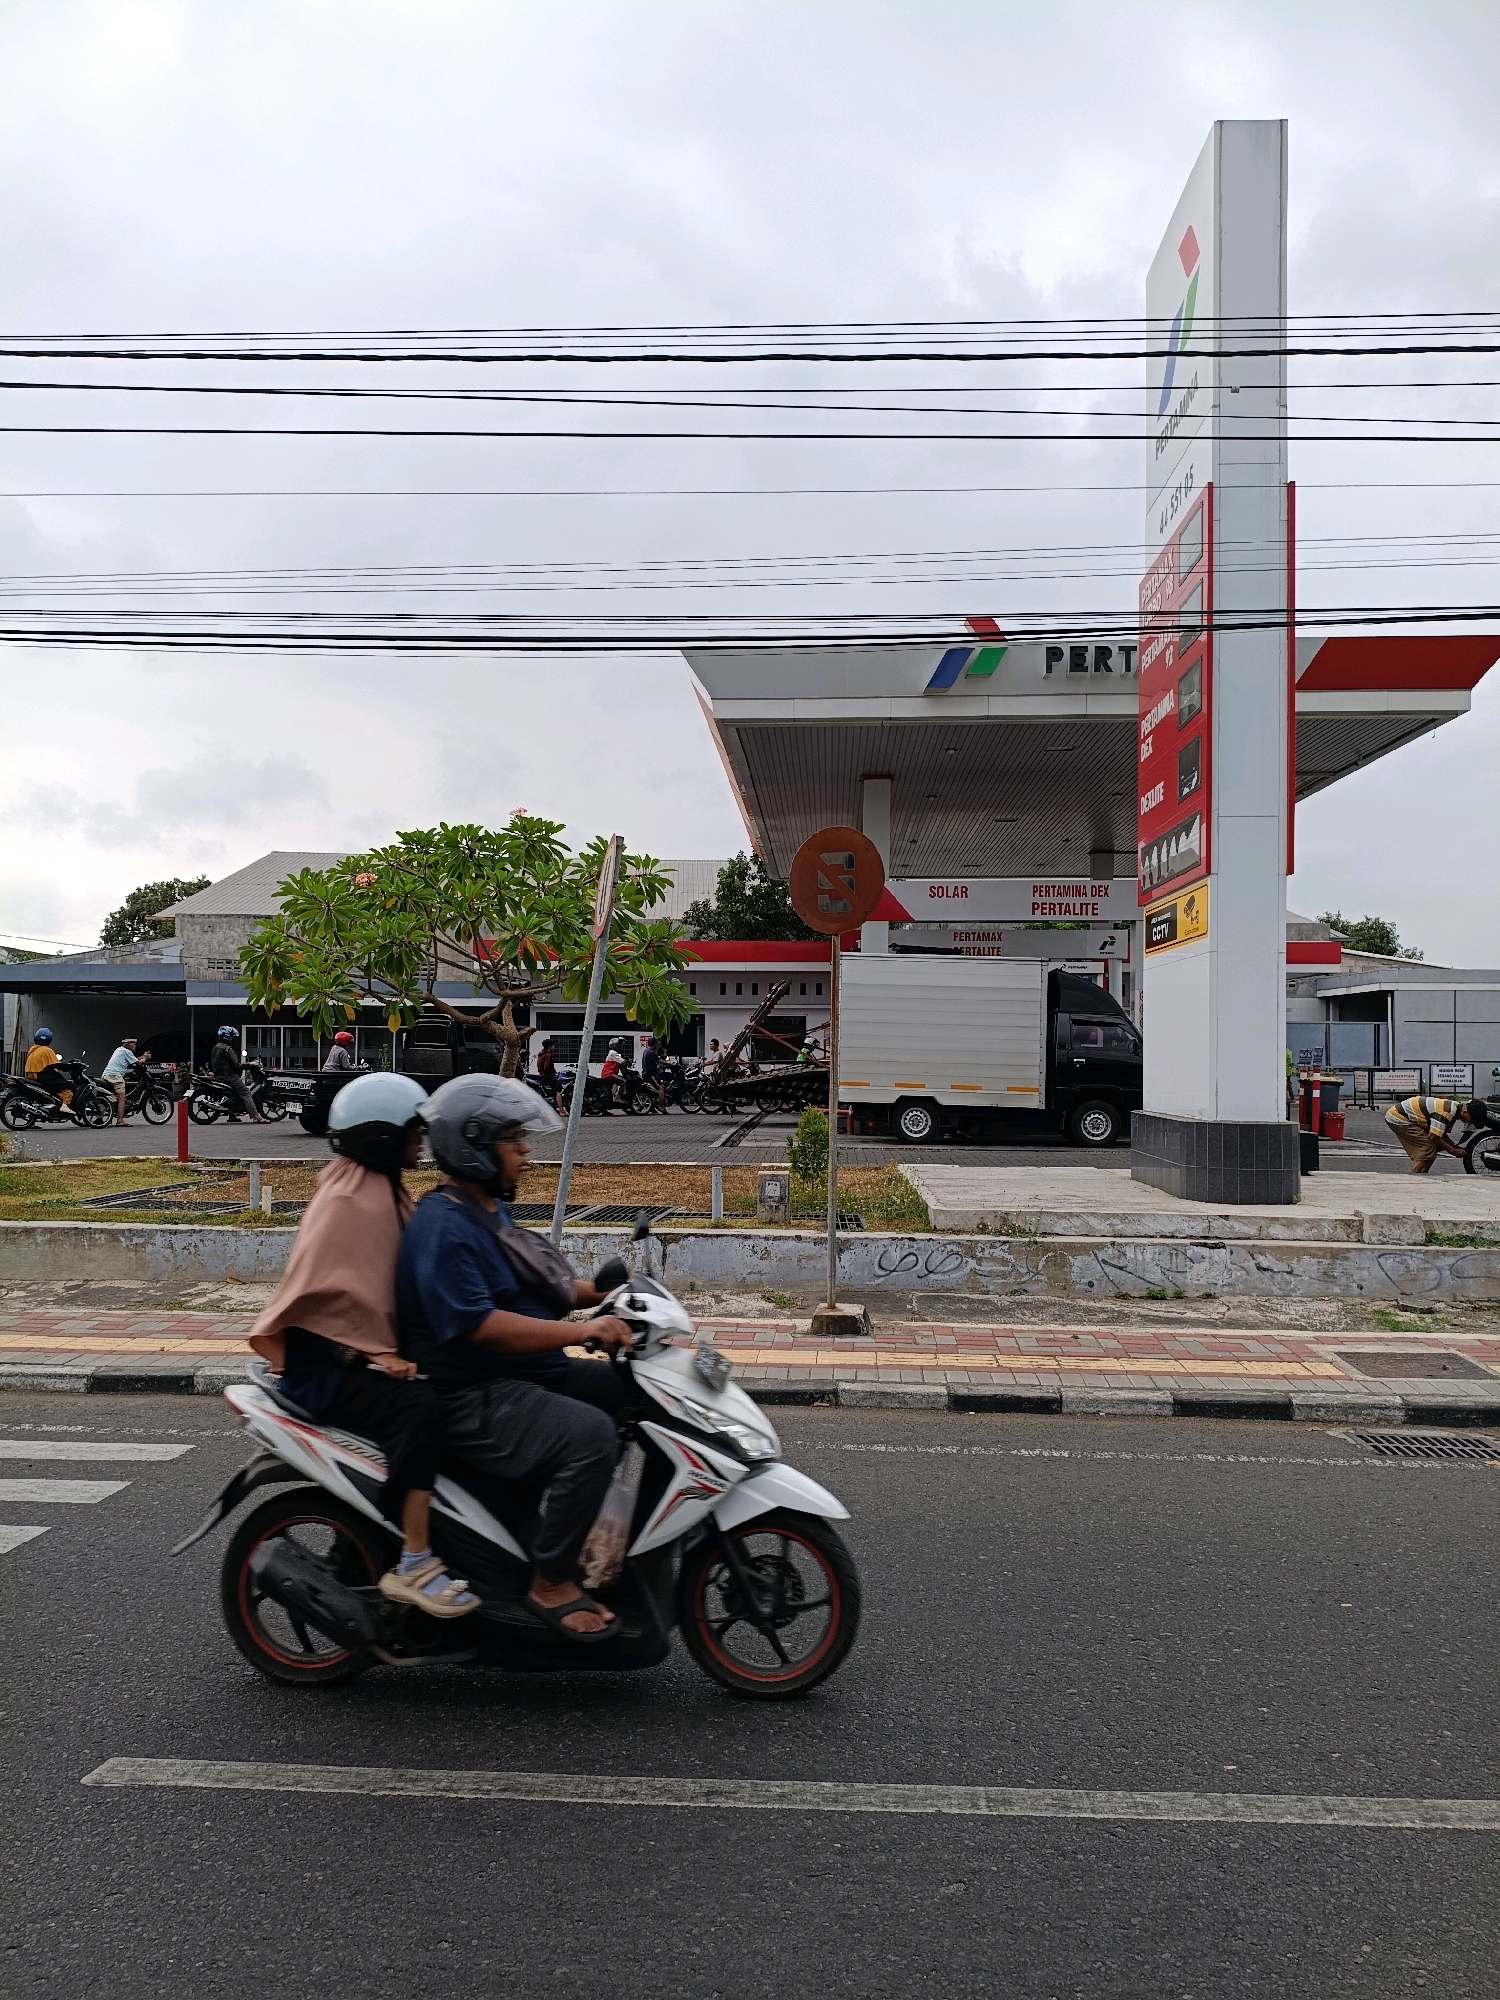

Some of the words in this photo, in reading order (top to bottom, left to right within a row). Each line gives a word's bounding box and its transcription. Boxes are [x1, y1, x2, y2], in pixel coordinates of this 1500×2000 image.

[1156, 370, 1198, 462] PERTAMINA
[1170, 481, 1182, 521] 551
[1141, 547, 1174, 609] PERTAMAX
[1044, 645, 1138, 674] PERT
[1165, 645, 1174, 670] 92
[1140, 688, 1174, 740] PERTAMINA
[1140, 734, 1153, 763] DEX
[1140, 780, 1165, 816] DEXLITE
[928, 885, 969, 899] SOLAR
[1032, 884, 1088, 898] PERTAMINA
[1090, 884, 1110, 898] DEX
[1031, 901, 1099, 916] PERTALITE
[953, 931, 1003, 942] PERTAMAX
[1152, 922, 1170, 942] CCTV
[953, 946, 1002, 957] ERTALITE
